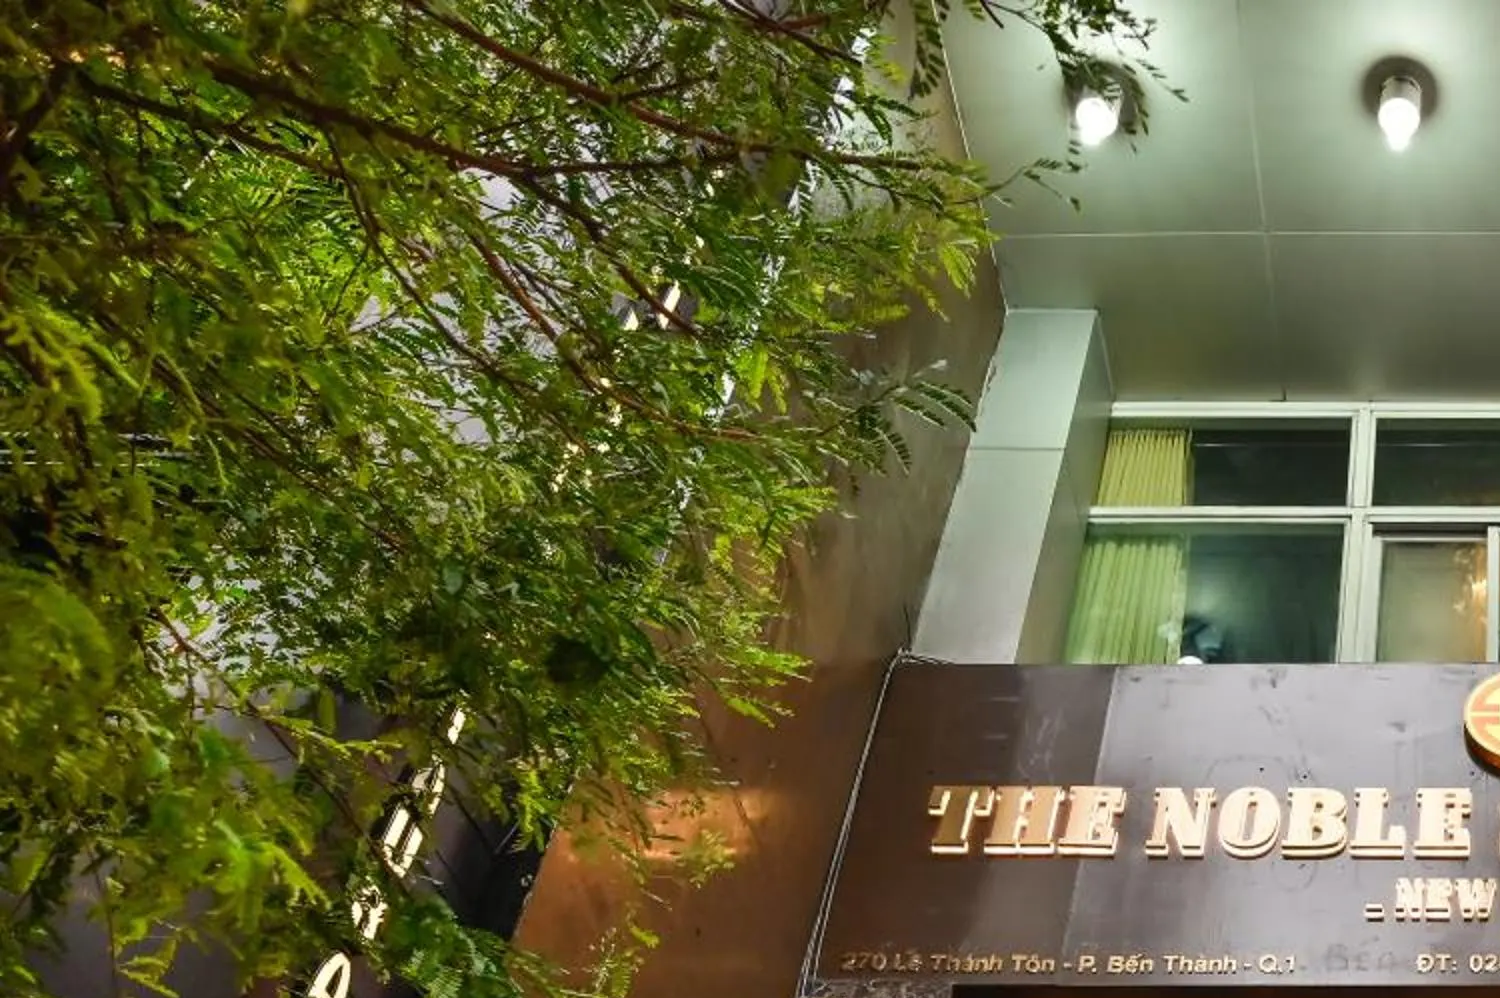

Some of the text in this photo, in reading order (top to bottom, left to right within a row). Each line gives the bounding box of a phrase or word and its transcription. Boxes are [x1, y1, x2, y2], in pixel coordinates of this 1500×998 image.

[928, 785, 1126, 857] THE
[1145, 786, 1473, 859] NOBLE
[1395, 877, 1497, 922] NEW
[841, 951, 887, 972] 270
[895, 948, 923, 972] Lê
[930, 949, 1003, 972] Thánh
[1012, 952, 1055, 973] Tôn
[1078, 954, 1097, 973] P.
[1107, 952, 1153, 974] Bến
[1163, 953, 1237, 974] Thành
[1416, 953, 1457, 973] ĐT:
